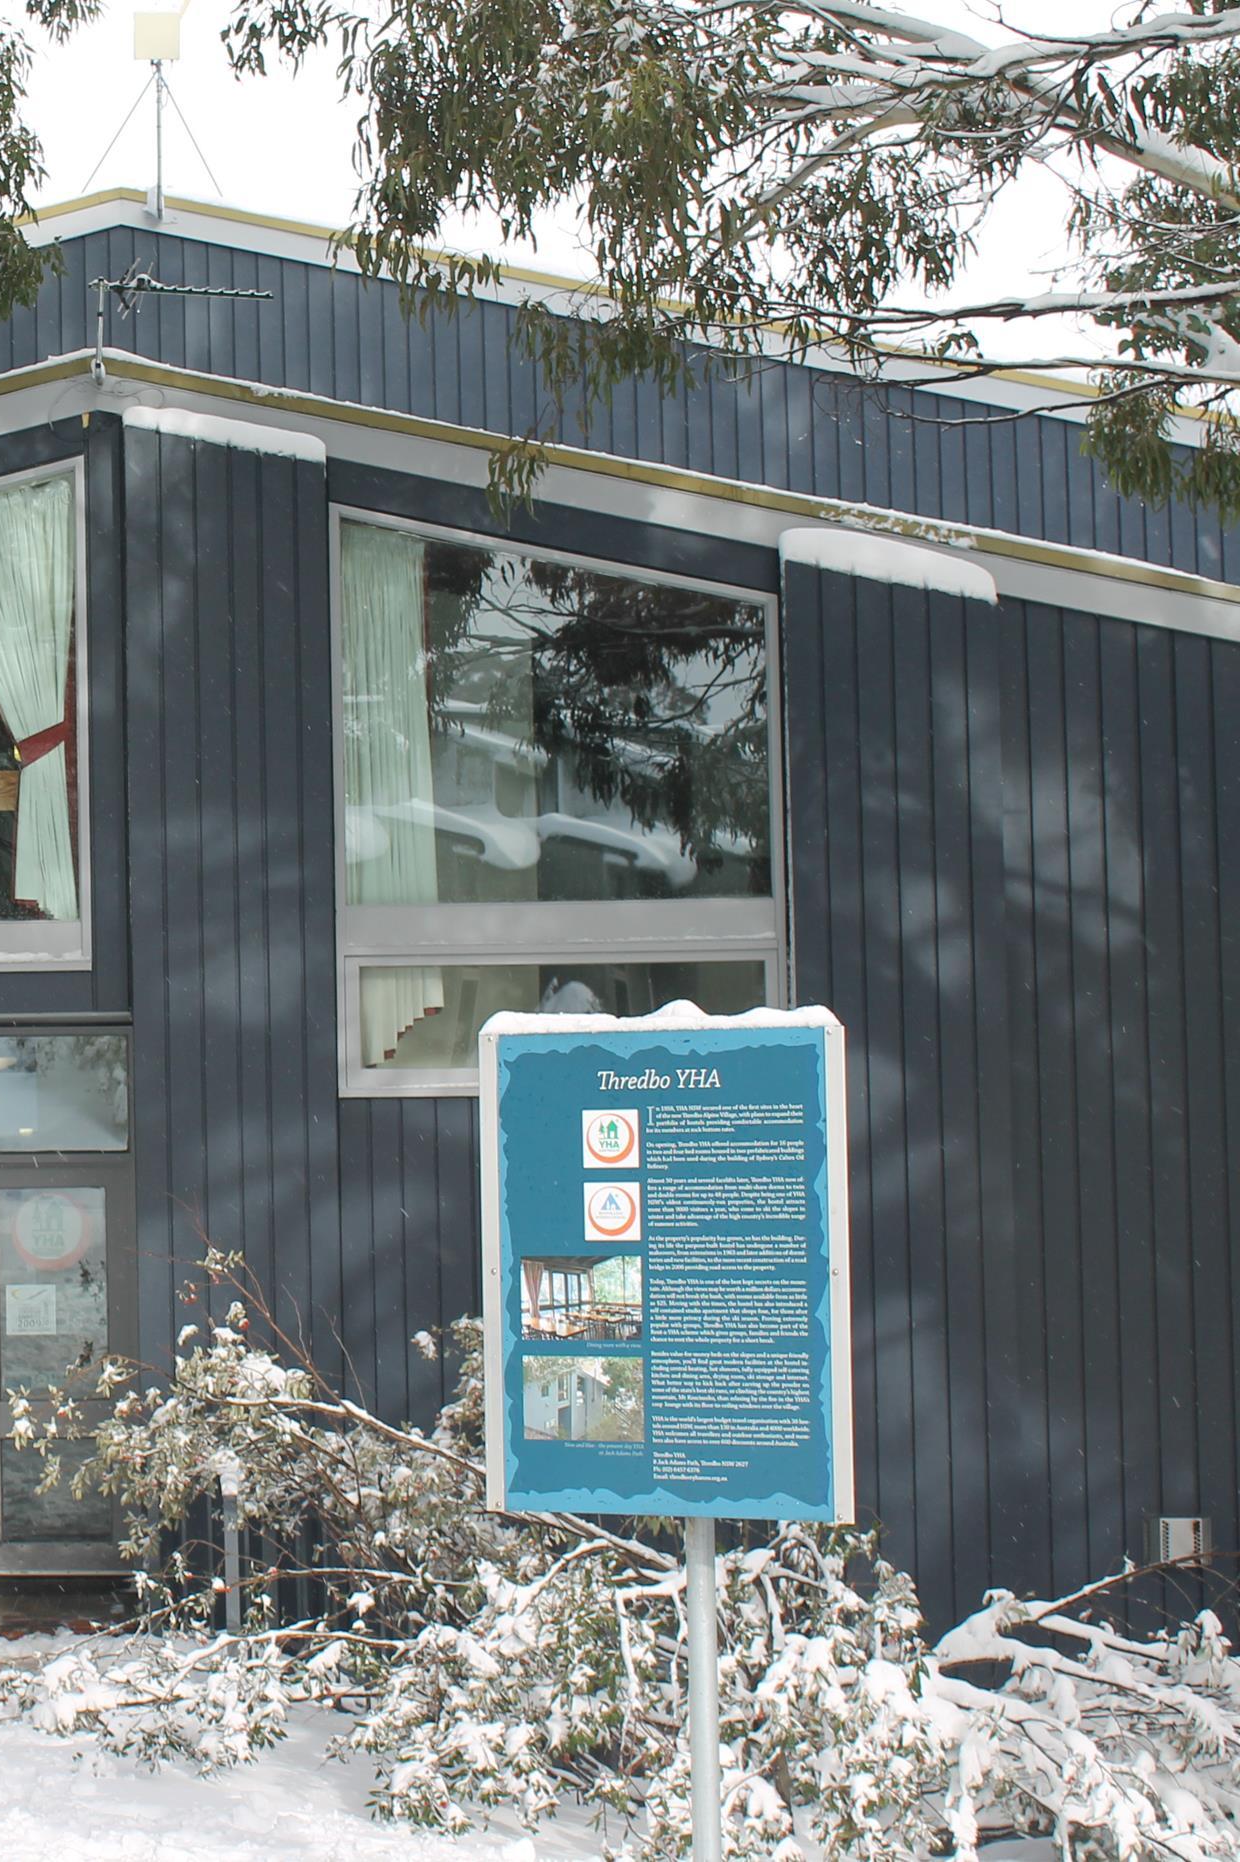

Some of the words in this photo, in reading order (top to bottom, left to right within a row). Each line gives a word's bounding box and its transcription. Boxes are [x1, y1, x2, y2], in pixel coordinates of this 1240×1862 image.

[597, 1069, 671, 1090] Thredbo
[676, 1069, 722, 1089] YHA
[599, 1140, 620, 1149] YHA
[32, 1234, 65, 1247] YHA
